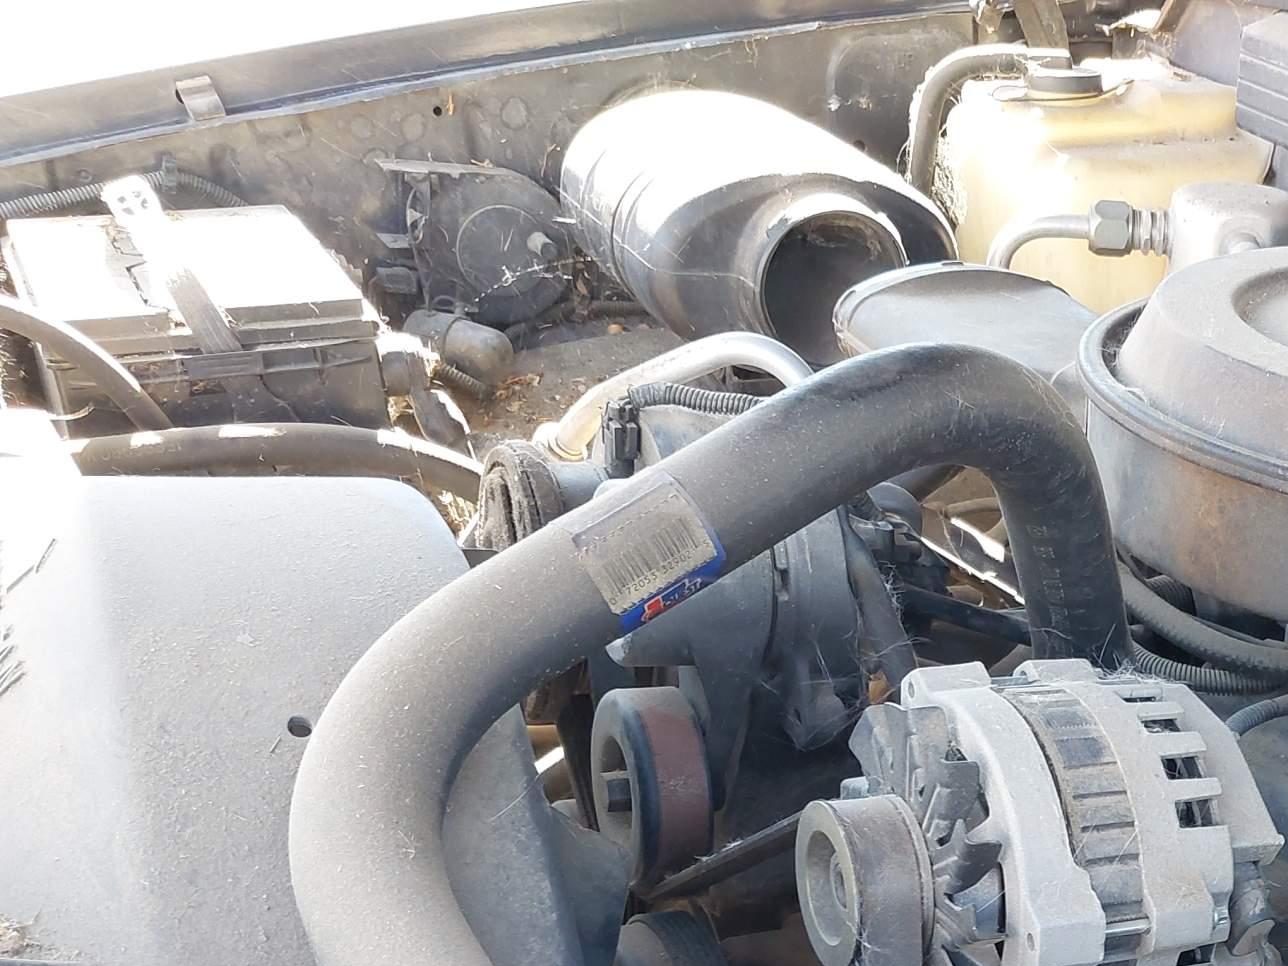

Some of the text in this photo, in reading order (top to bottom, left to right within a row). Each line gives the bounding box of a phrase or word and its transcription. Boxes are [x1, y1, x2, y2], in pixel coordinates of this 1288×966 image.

[609, 597, 618, 606] 0
[625, 571, 658, 595] 72053
[661, 549, 694, 575] 32902
